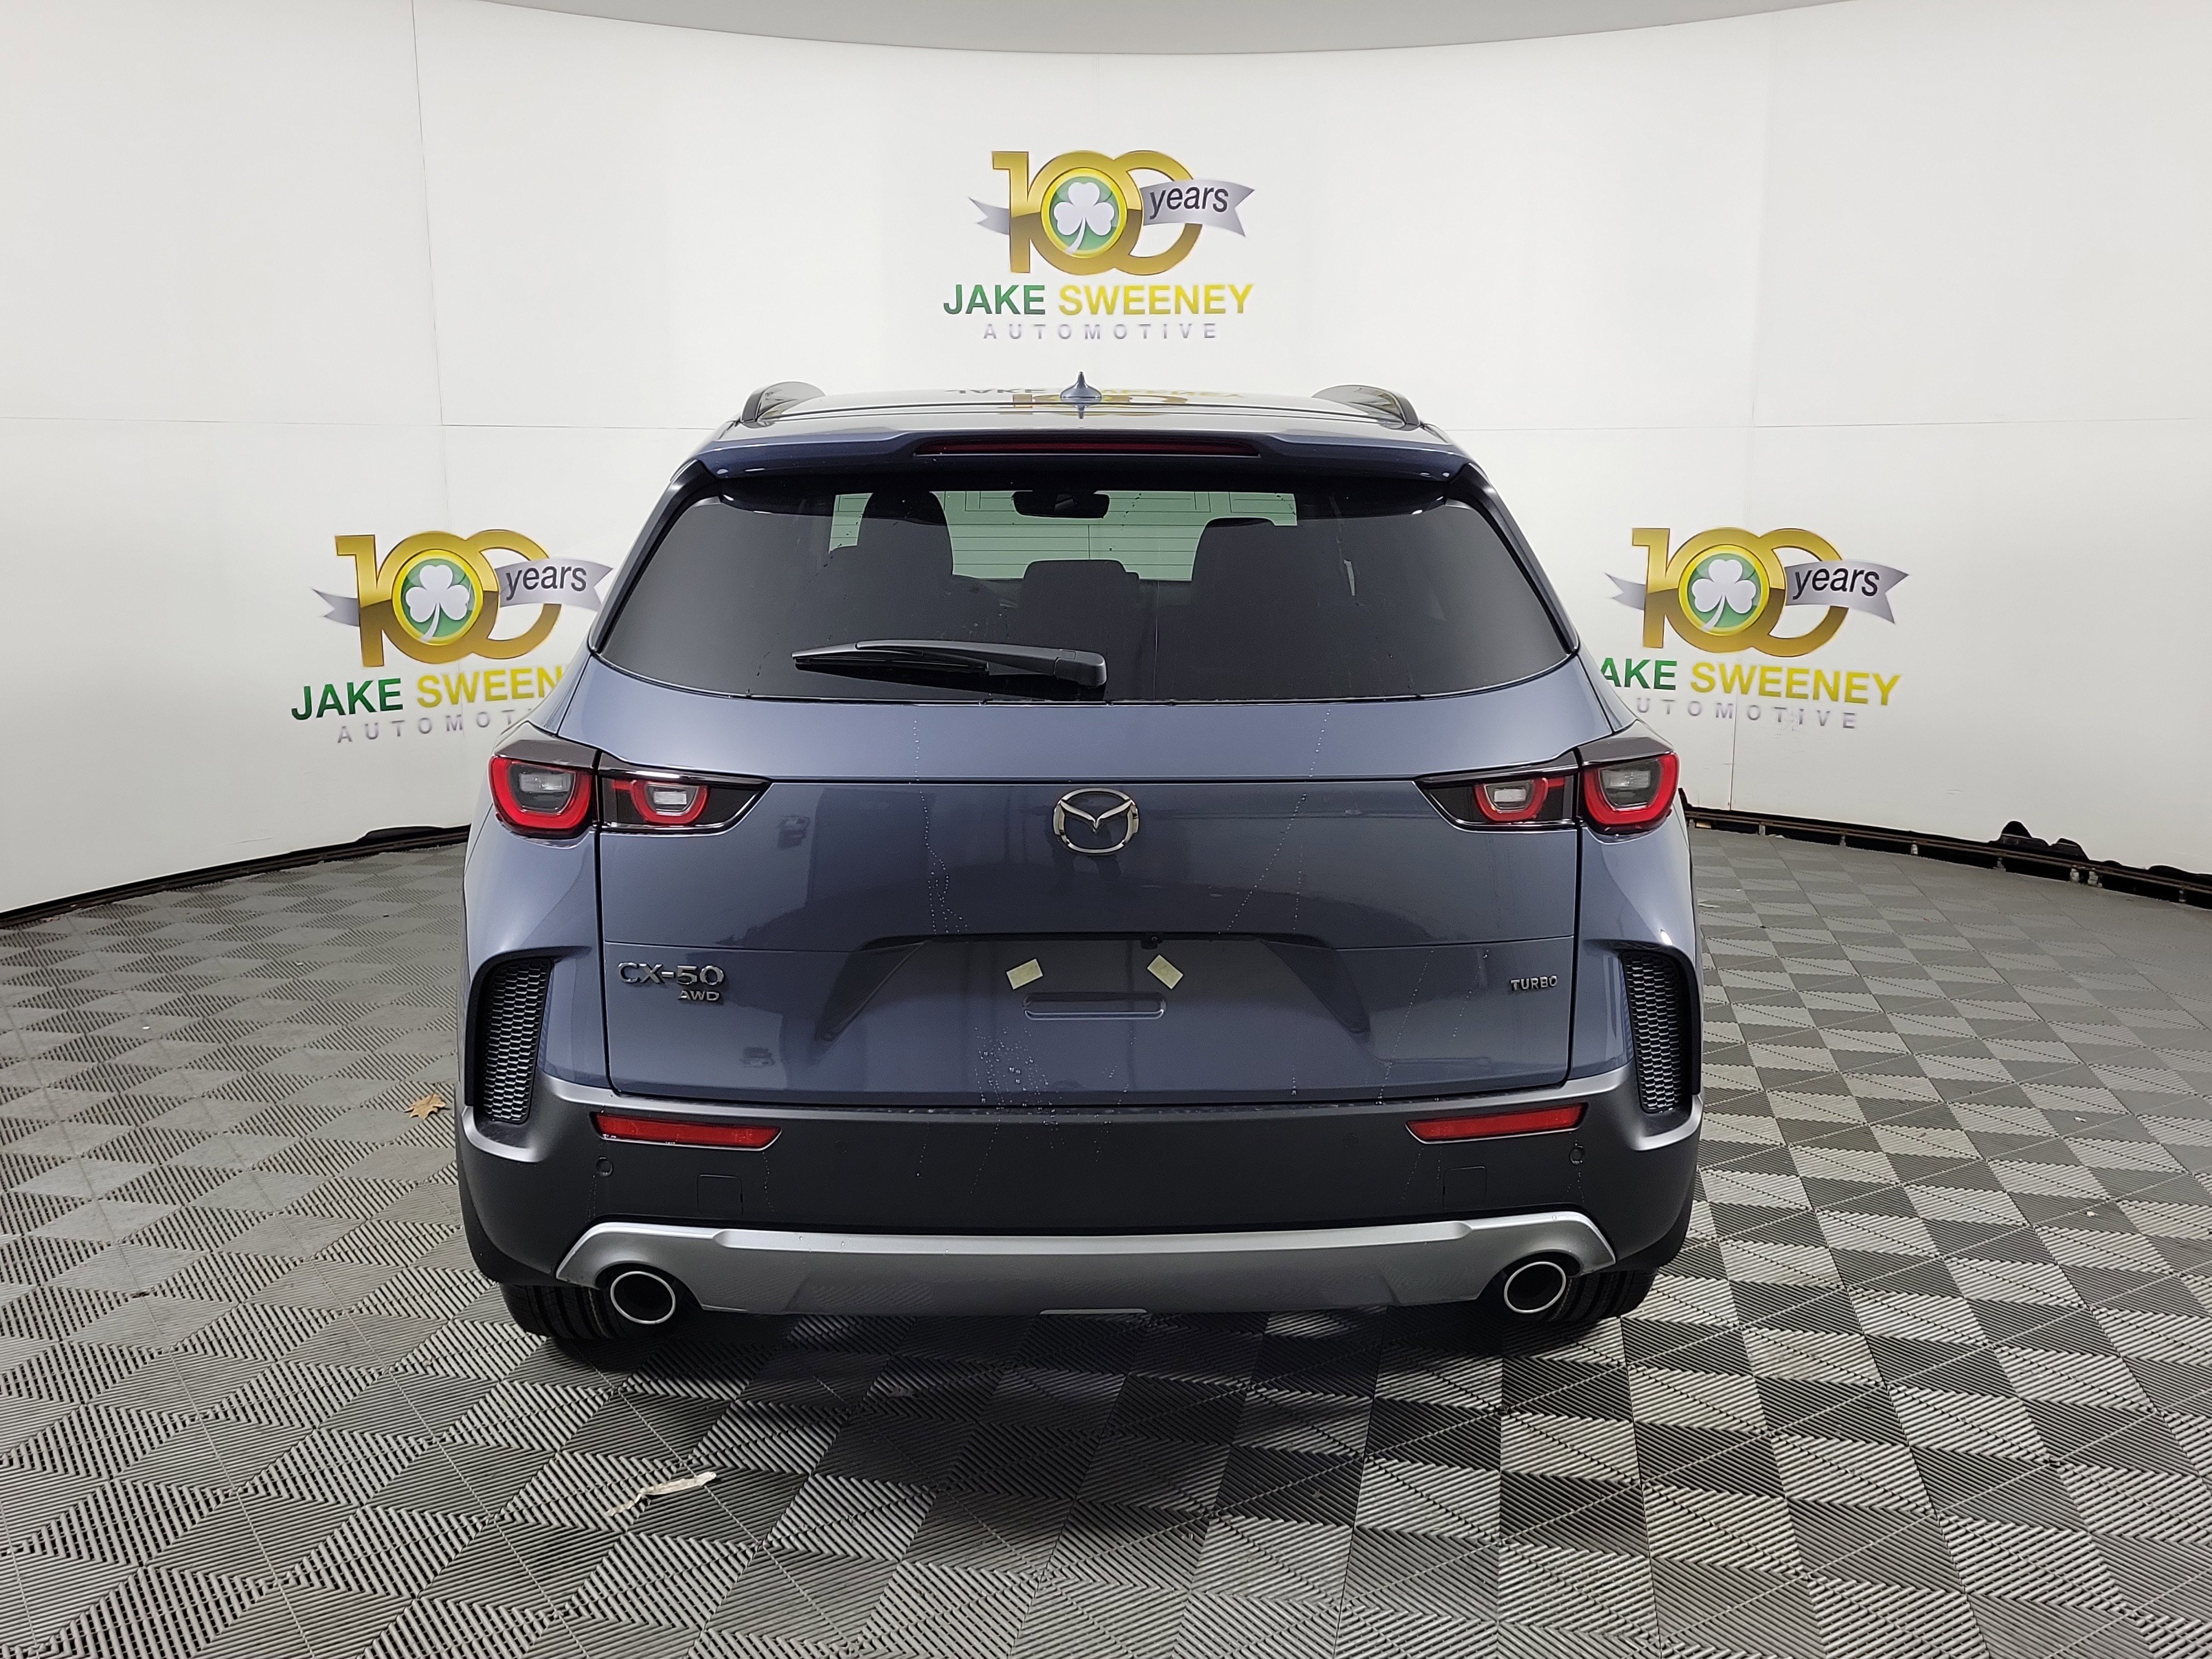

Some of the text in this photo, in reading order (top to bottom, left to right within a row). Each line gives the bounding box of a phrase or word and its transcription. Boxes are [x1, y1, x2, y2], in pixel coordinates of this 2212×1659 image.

[991, 150, 1229, 276] 100 years
[943, 283, 1255, 316] JAKE SWEENEY
[983, 323, 1217, 340] AUTOMOTIVE
[335, 529, 587, 668] 100 years
[1632, 527, 1880, 657] 100 years
[291, 665, 563, 720] JAKE SWEEN
[1600, 657, 1902, 706] AKE SWEENEY
[337, 709, 516, 744] AUTOMOT
[1637, 697, 1857, 729] UTOMOTIVE
[618, 962, 725, 985] CX-50
[1510, 975, 1558, 991] TURBO
[678, 990, 720, 1001] AWD
